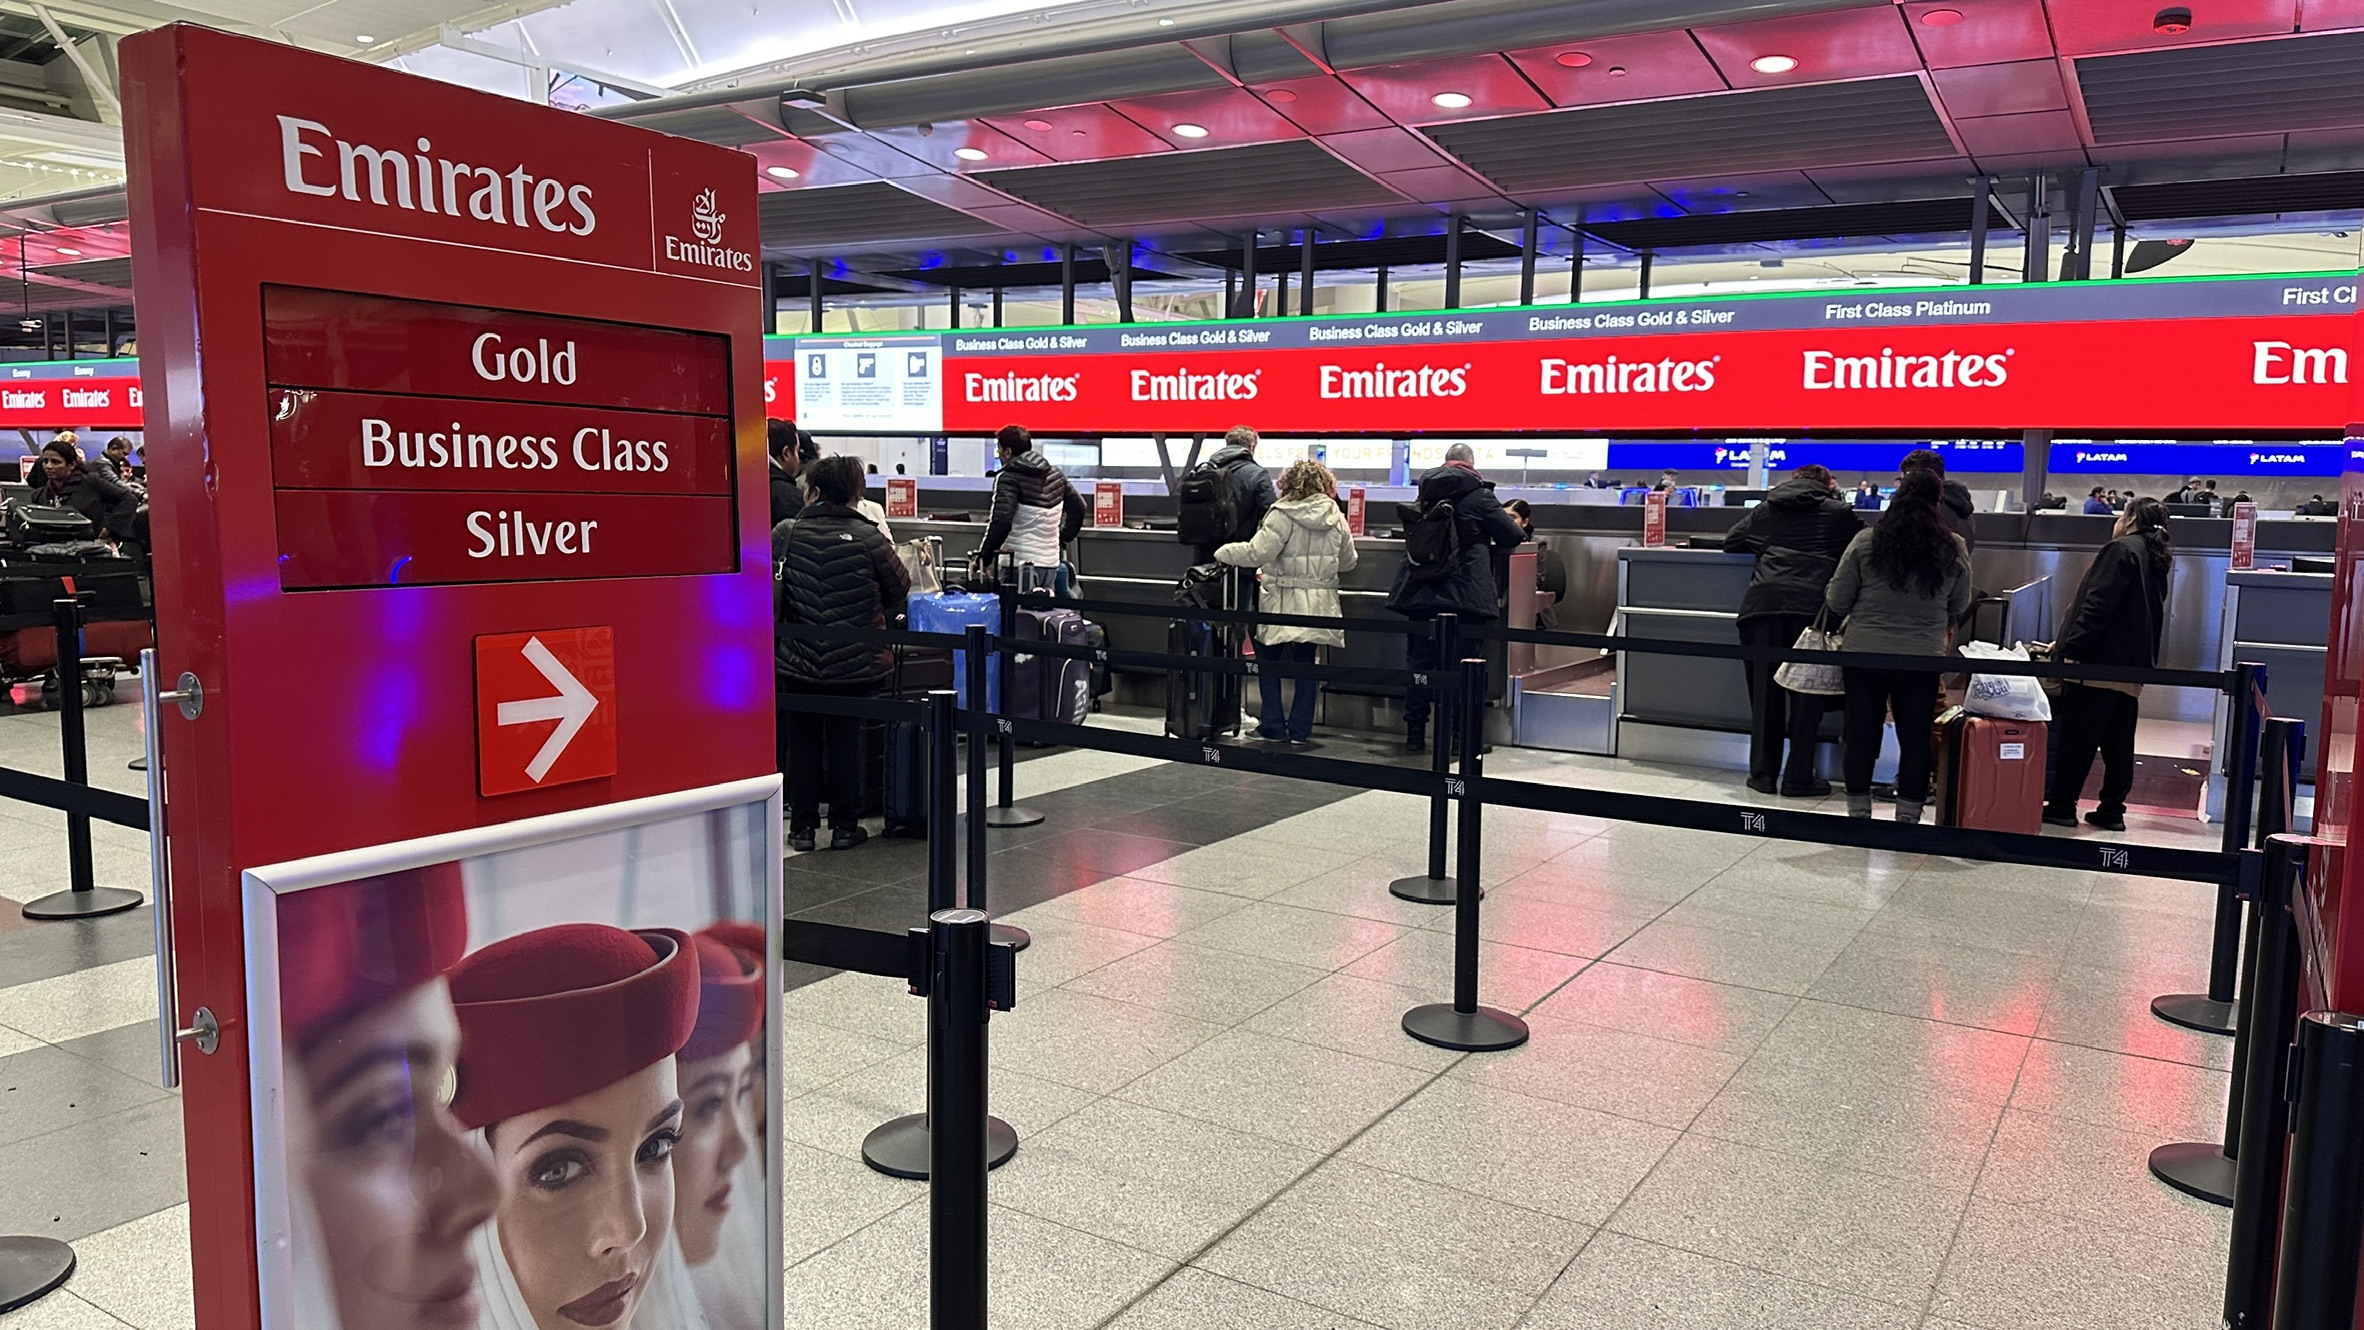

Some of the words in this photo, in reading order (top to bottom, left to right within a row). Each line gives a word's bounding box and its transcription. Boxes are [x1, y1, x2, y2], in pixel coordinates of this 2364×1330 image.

[275, 114, 597, 237] Emirates
[665, 235, 753, 272] Emirates
[2282, 287, 2330, 306] First
[1528, 315, 1592, 331] Business
[1593, 313, 1635, 328] Class
[1637, 311, 1673, 327] Gold
[1674, 310, 1688, 325] &
[1690, 309, 1736, 325] Silver
[1825, 303, 1863, 320] First
[1864, 302, 1913, 318] Class
[1915, 299, 1991, 317] Platinum
[1120, 332, 1168, 347] Business
[1168, 331, 1199, 346] Class
[1199, 330, 1227, 344] Gold
[1226, 329, 1237, 344] &
[1238, 328, 1271, 343] Silver
[1309, 325, 1363, 341] Business
[1364, 323, 1399, 338] Class
[1400, 321, 1431, 337] Gold
[1432, 321, 1444, 336] &
[1445, 320, 1484, 336] Silver
[955, 338, 997, 352] Business
[997, 337, 1025, 351] Class
[1025, 336, 1049, 350] Gold
[1049, 336, 1059, 349] &
[1059, 335, 1088, 349] Silver
[472, 332, 577, 386] Gold
[1803, 347, 2009, 390] Emirates
[1130, 367, 1259, 401] Emirates
[1319, 362, 1468, 399] Emirates
[1540, 355, 1716, 395] Emirates
[964, 371, 1079, 402] Emirates
[2, 389, 46, 409] Emirates
[62, 387, 110, 408] Emirates
[361, 418, 559, 471] Business
[572, 427, 669, 472] Class
[1728, 450, 1786, 461] LAM
[2085, 453, 2128, 463] LATAM
[2259, 454, 2306, 464] LATAM
[466, 510, 598, 558] Silver
[1245, 662, 1259, 674] T4
[1412, 673, 1428, 685] T4
[996, 718, 1013, 735] T4
[1202, 746, 1221, 763] T4
[1444, 777, 1466, 796] T4
[1739, 811, 1766, 832] T4
[2098, 846, 2130, 869] T4
